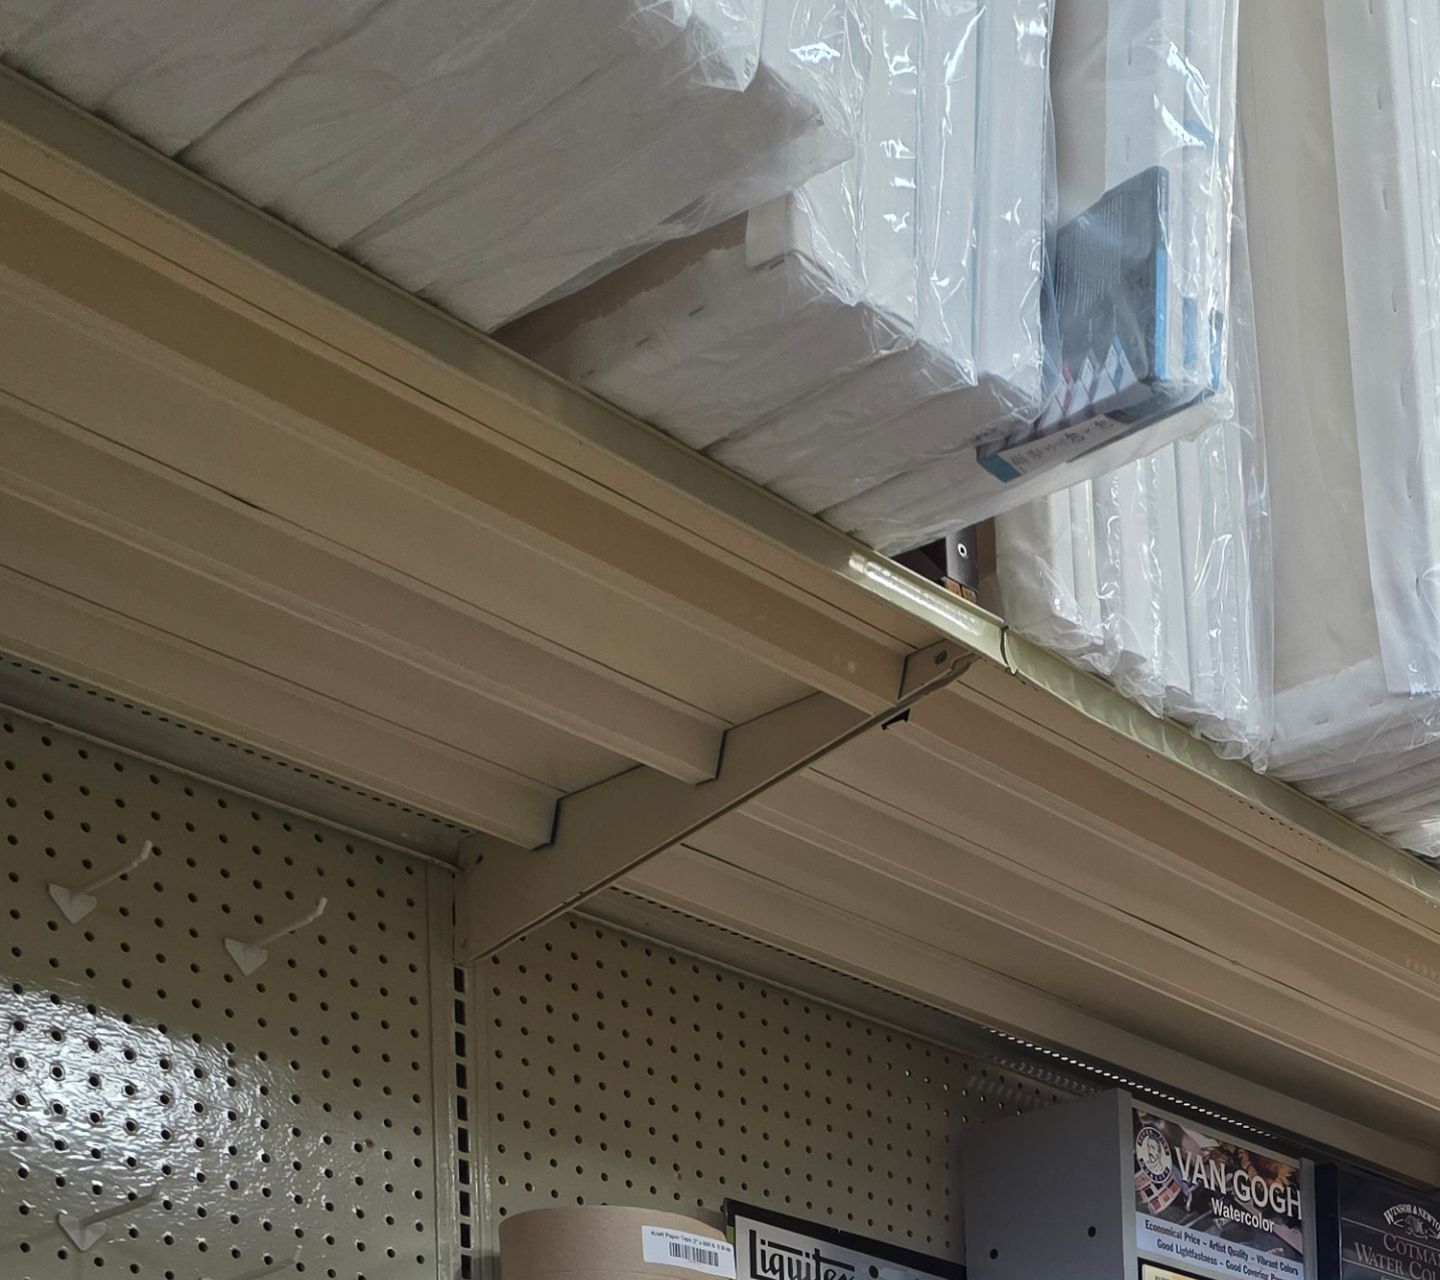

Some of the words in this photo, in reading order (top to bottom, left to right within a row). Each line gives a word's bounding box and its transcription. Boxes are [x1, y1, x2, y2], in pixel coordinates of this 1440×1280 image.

[1175, 1146, 1226, 1195] VAN
[1233, 1169, 1302, 1220] GOGH
[1211, 1197, 1274, 1233] Watercolor
[1145, 1219, 1183, 1241] Economical
[1184, 1231, 1201, 1246] Price
[1209, 1240, 1226, 1254] Artist
[1228, 1245, 1249, 1262] Quality
[1256, 1254, 1279, 1270] Vibrant
[1280, 1261, 1299, 1276] Colors
[1157, 1239, 1174, 1253] Good
[1176, 1243, 1218, 1266] Lightfastness
[1226, 1260, 1242, 1274] Good
[1354, 1241, 1405, 1276] WATER
